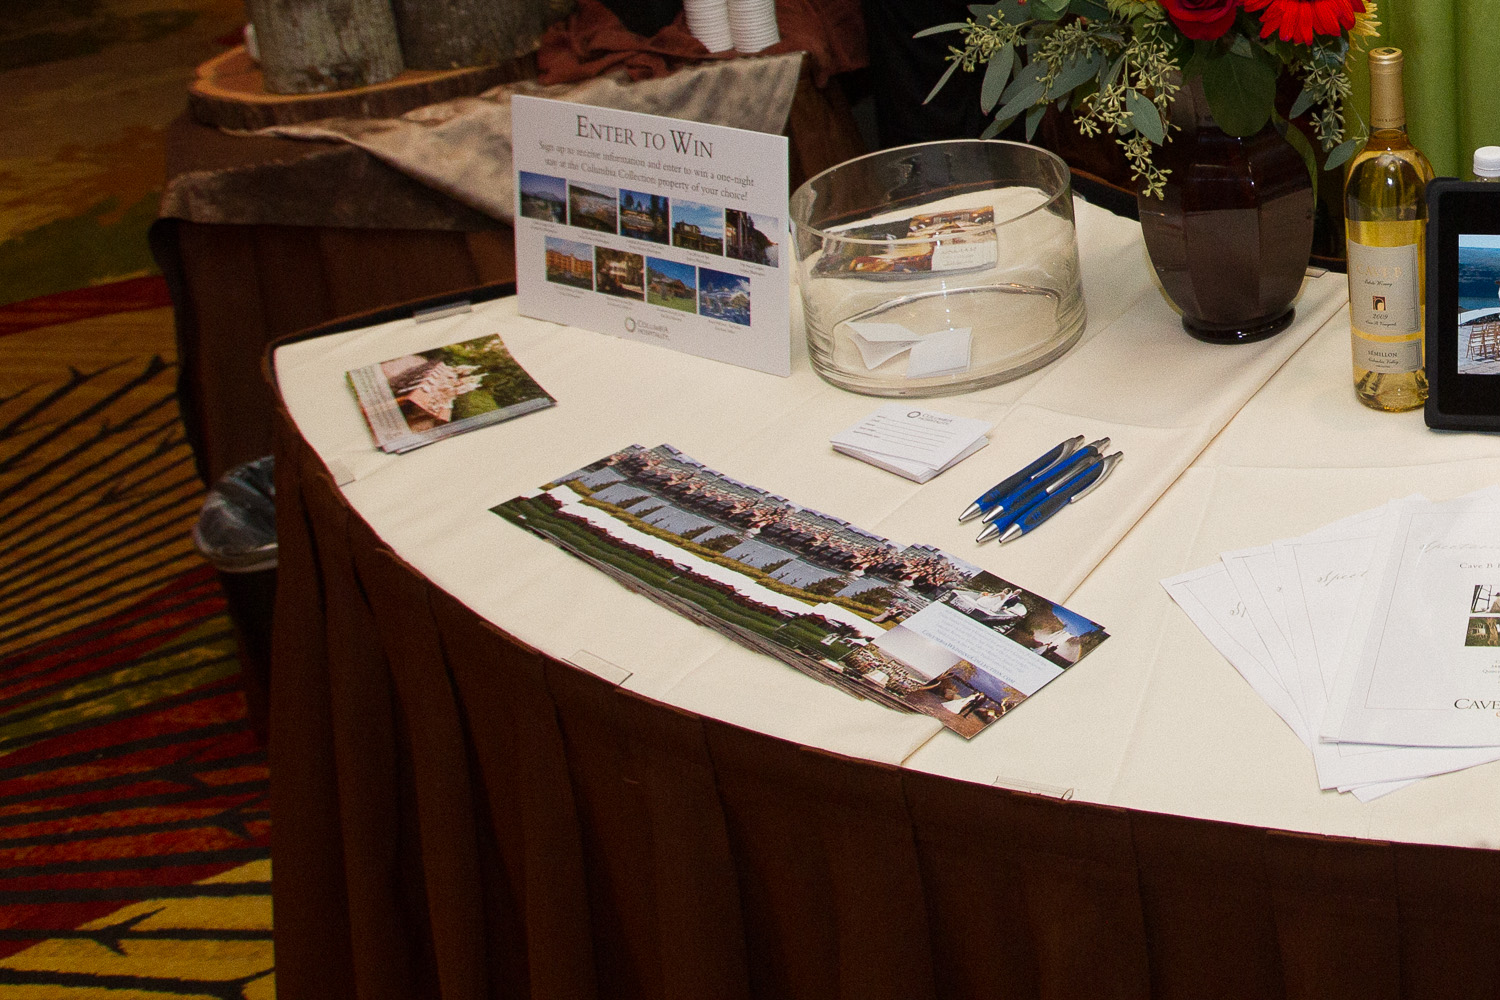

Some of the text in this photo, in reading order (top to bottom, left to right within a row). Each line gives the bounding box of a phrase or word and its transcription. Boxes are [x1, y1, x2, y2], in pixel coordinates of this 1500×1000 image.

[575, 114, 713, 158] ENTER TO WIN
[580, 162, 616, 177] Columbia
[618, 169, 656, 184] Collection
[657, 178, 689, 191] property
[691, 182, 700, 192] of
[700, 186, 719, 196] your
[720, 187, 748, 201] choice!
[603, 152, 646, 167] information
[648, 160, 660, 169] and
[663, 164, 681, 174] enter
[684, 166, 691, 175] to
[694, 169, 708, 178] win
[716, 174, 754, 188] one-night
[1454, 698, 1500, 710] CAVE
